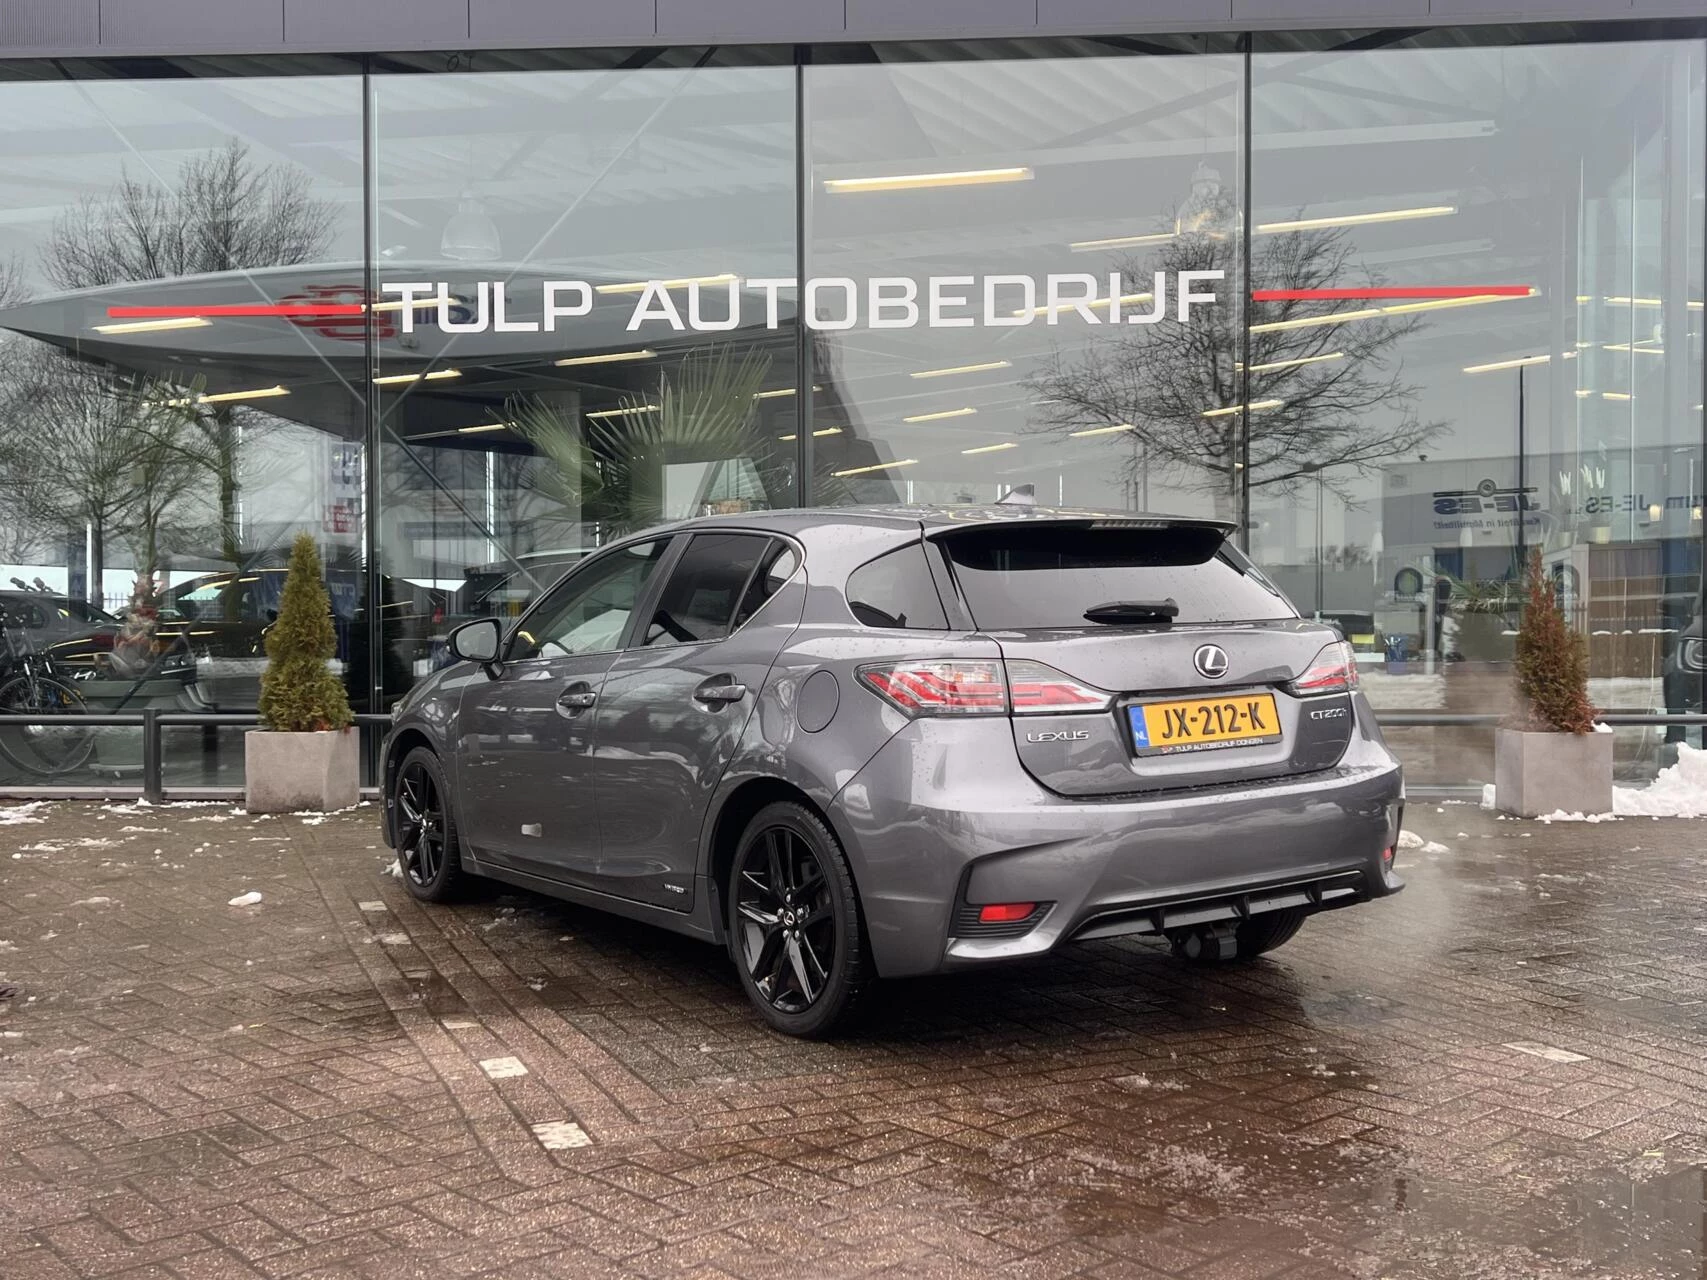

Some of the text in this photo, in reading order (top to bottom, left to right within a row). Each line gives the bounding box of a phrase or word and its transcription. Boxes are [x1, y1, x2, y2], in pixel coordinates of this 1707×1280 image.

[381, 280, 594, 334] TULP
[626, 270, 1225, 331] AUTOBEDRIJF
[1162, 702, 1266, 740] JX-212-K
[1026, 730, 1090, 743] LEXUS
[1135, 730, 1147, 741] NL
